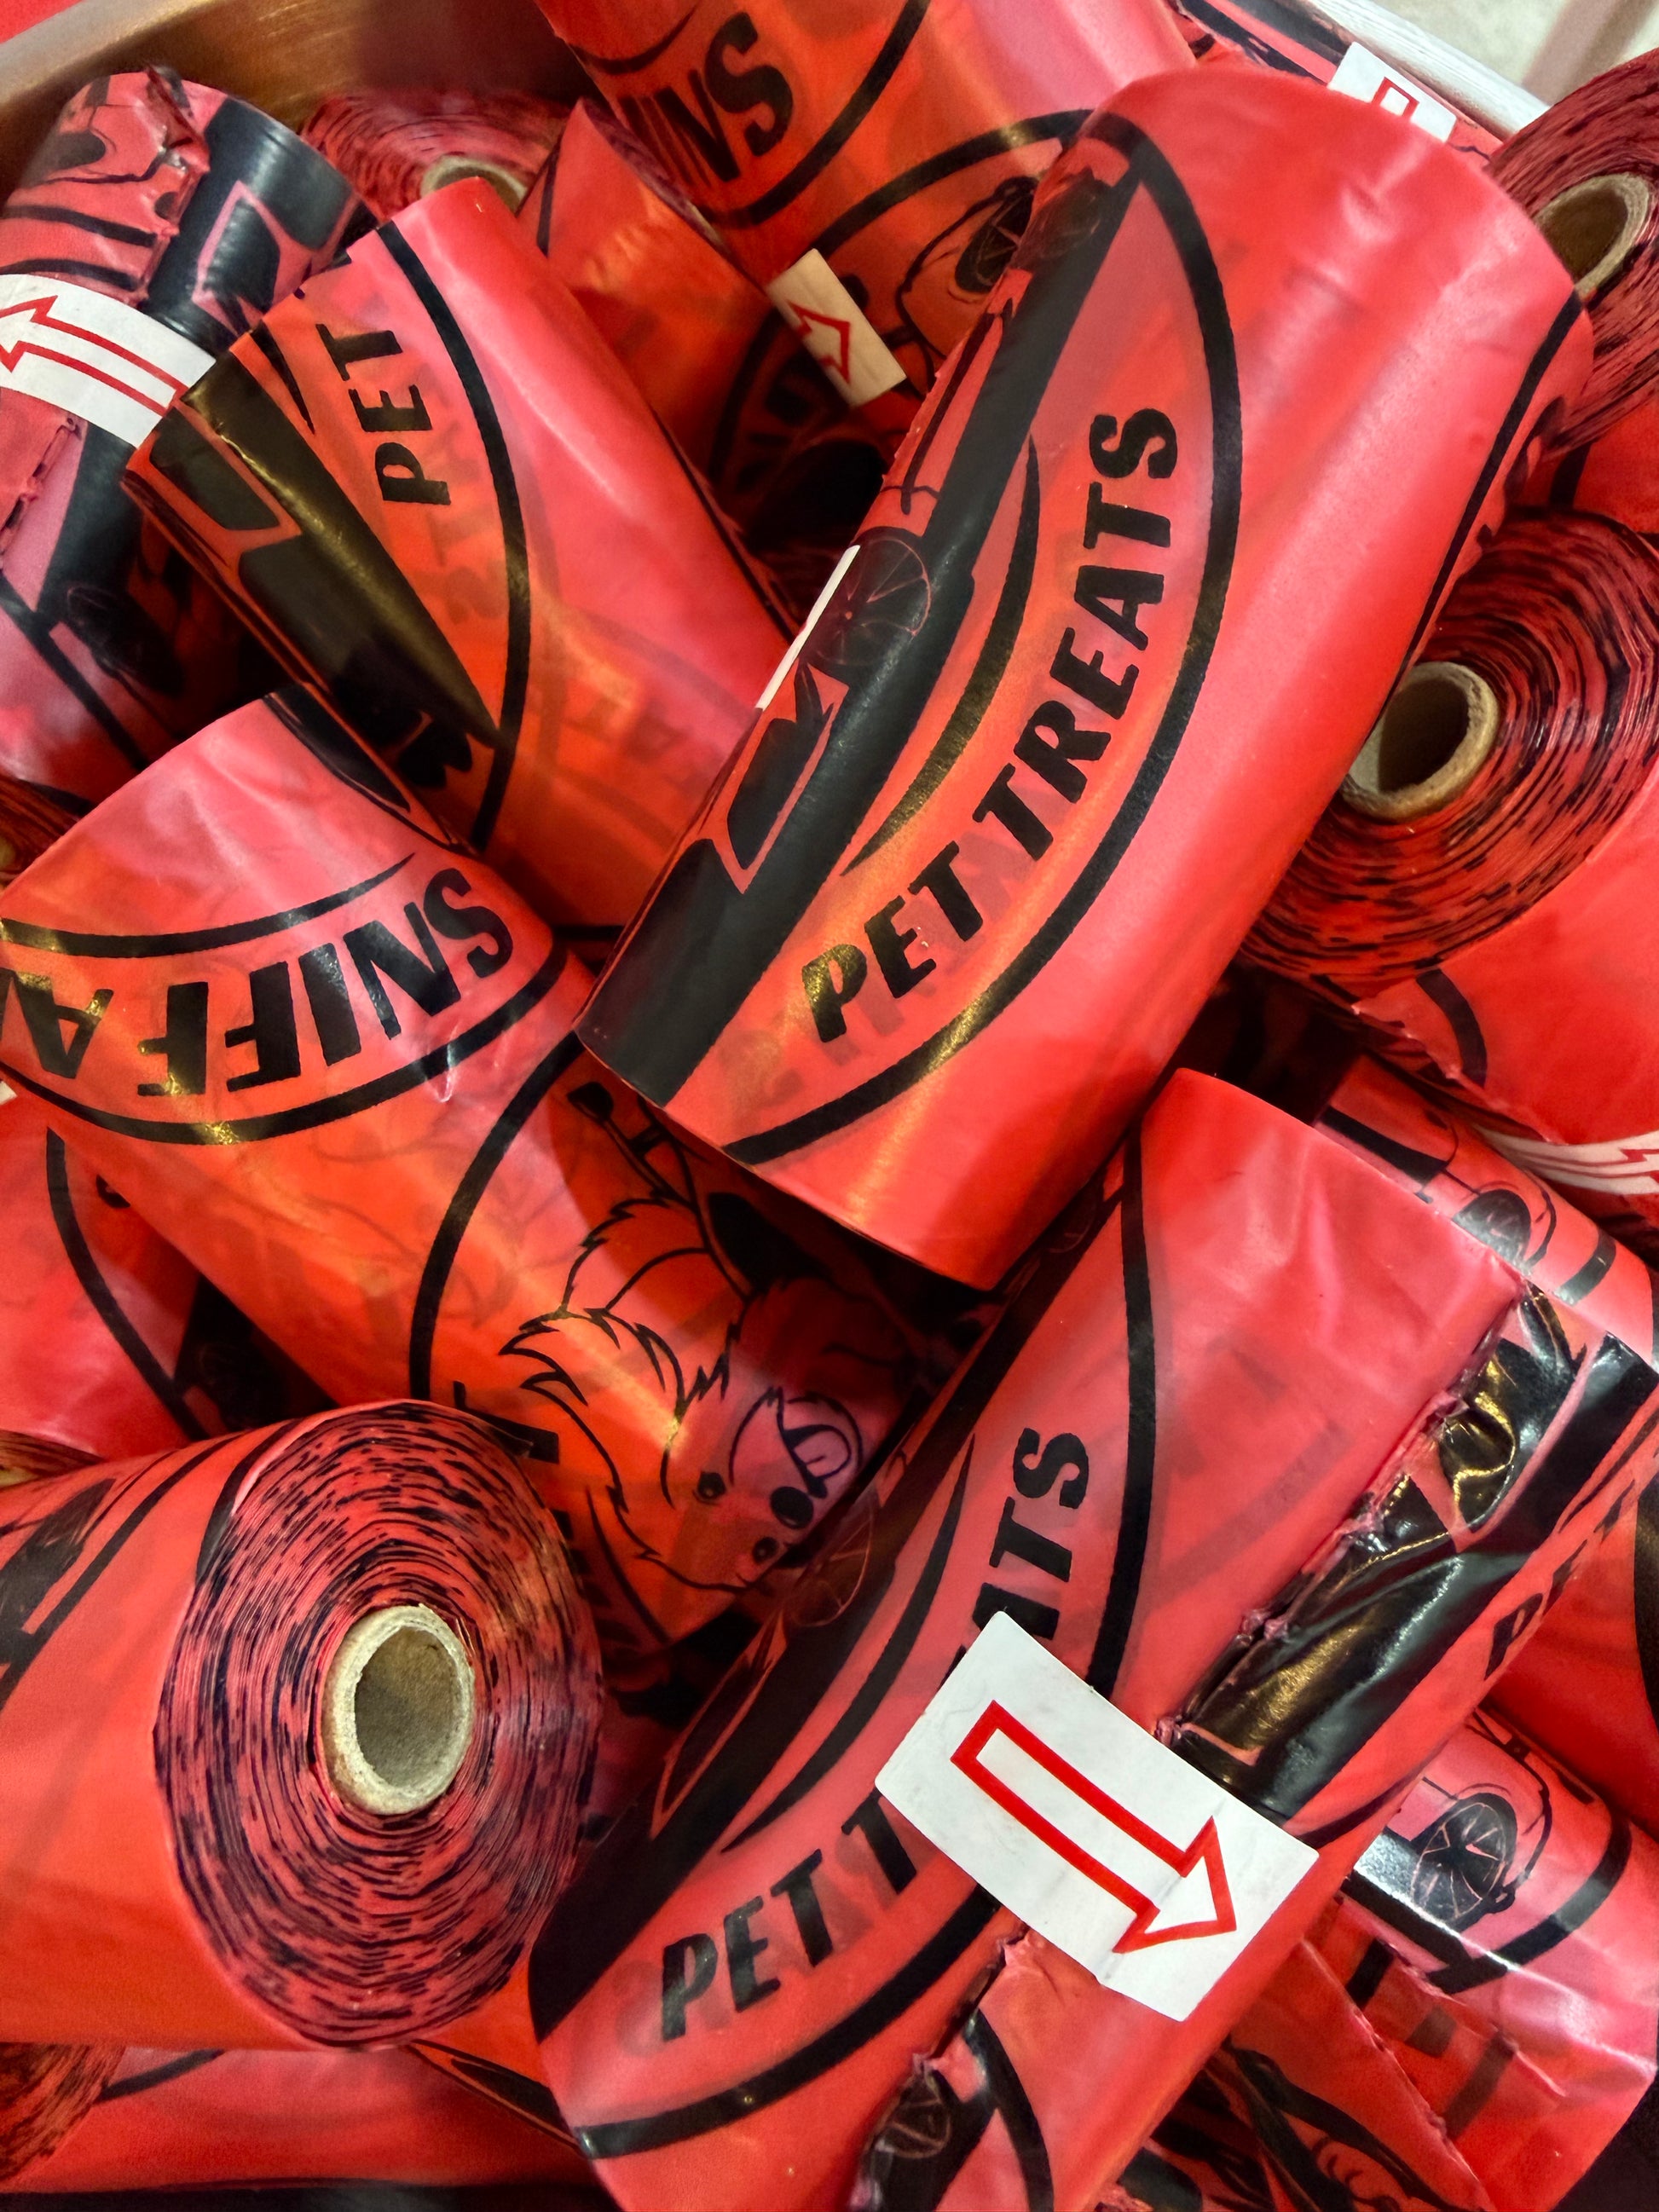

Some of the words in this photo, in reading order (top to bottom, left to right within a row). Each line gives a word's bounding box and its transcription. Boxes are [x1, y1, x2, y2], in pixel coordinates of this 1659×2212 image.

[315, 323, 452, 506] PET
[801, 840, 984, 1043] PET
[973, 407, 1178, 862] TREATS
[0, 867, 513, 1097] SNIFFA
[662, 1848, 833, 2042] PET
